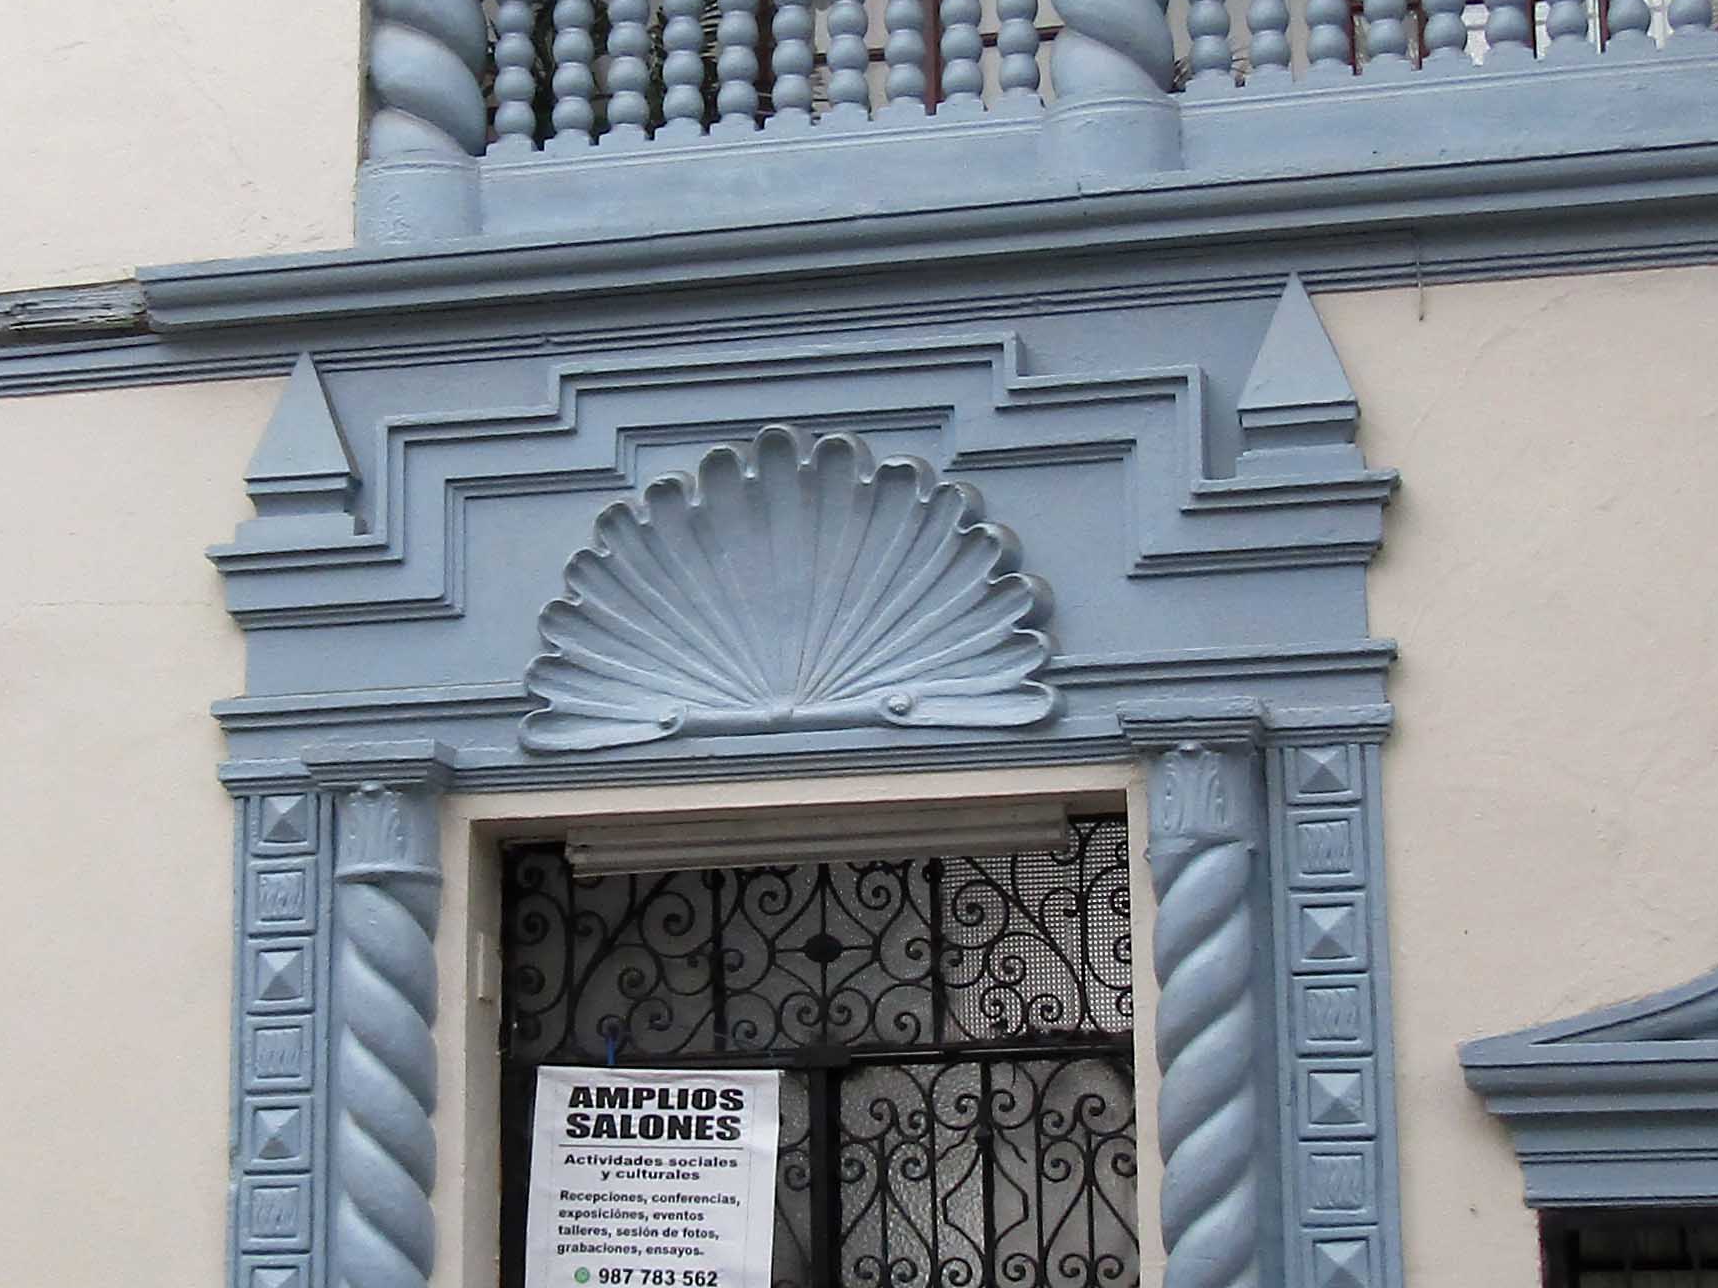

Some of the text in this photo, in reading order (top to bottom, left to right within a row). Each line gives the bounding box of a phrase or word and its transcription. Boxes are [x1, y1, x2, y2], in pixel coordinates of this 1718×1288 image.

[568, 1086, 744, 1110] AMPLIOS
[566, 1114, 741, 1140] SALONES
[564, 1155, 738, 1168] Actividades sociales
[601, 1168, 700, 1181] y culturales
[560, 1190, 740, 1206] Recepciones, conferencias,
[653, 1210, 704, 1221] eventos
[558, 1225, 719, 1240] talleres, sesión de fotos,
[557, 1242, 642, 1256] grabaciones,
[599, 1268, 718, 1287] 987 783 562
